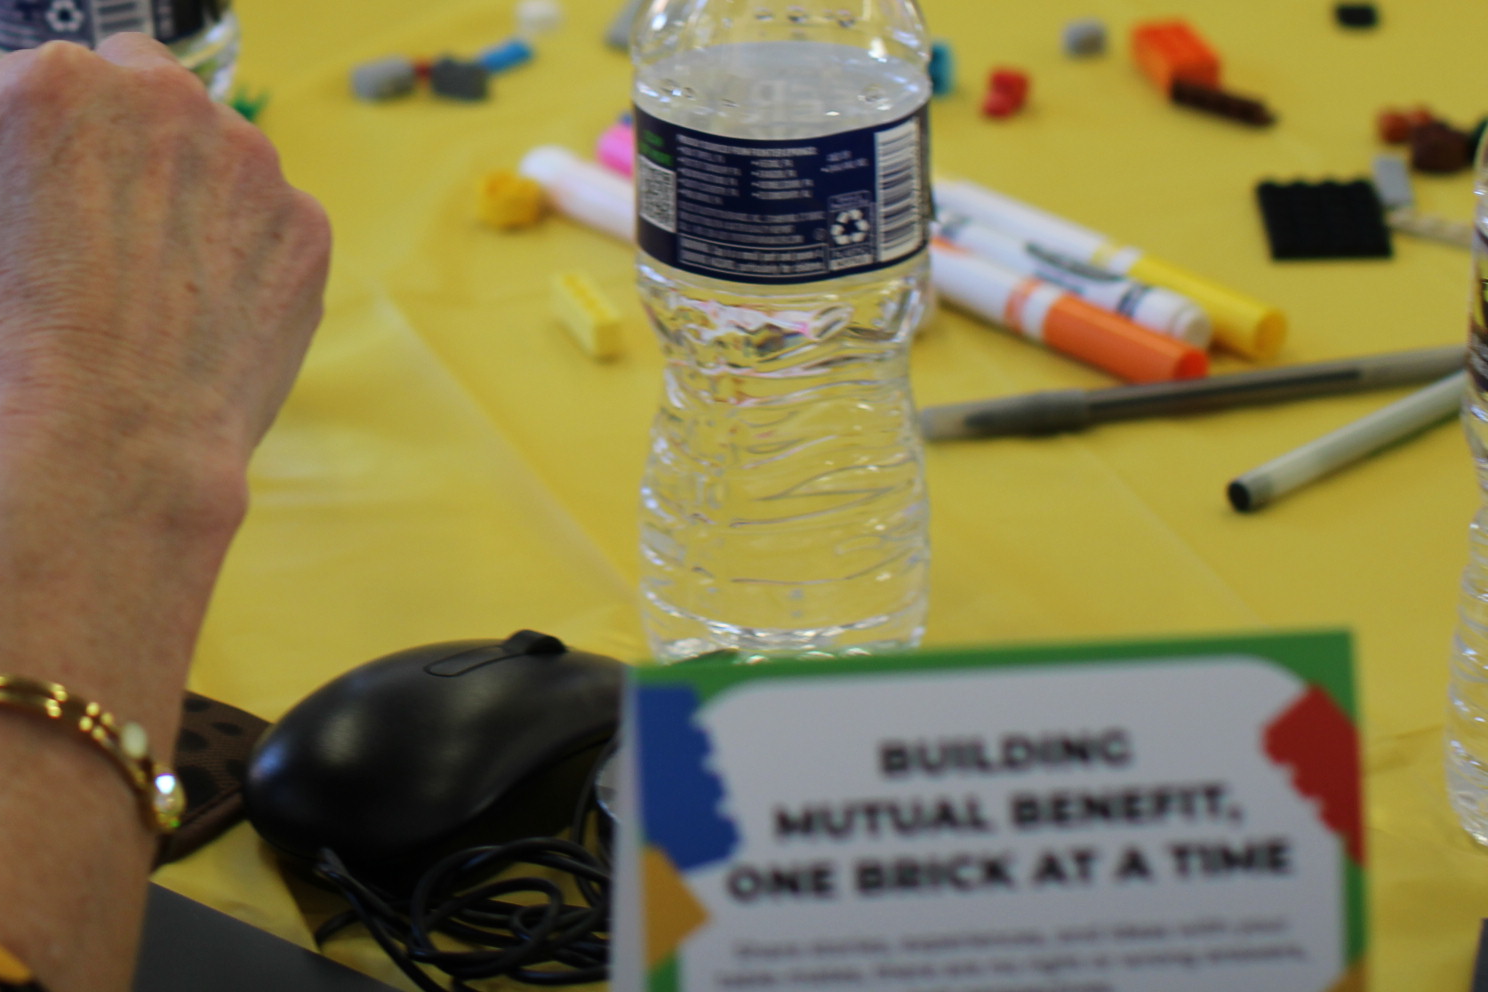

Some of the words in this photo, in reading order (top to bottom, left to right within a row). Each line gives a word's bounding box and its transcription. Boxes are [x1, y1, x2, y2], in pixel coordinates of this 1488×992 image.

[878, 731, 1132, 775] BUILDING
[774, 798, 991, 841] MUTUAL
[1011, 785, 1243, 830] BENEFIT,
[725, 861, 836, 900] ONE
[855, 852, 1013, 896] BRICK
[1032, 848, 1096, 885] AT
[1115, 846, 1152, 883] A
[1169, 838, 1290, 876] TIME
